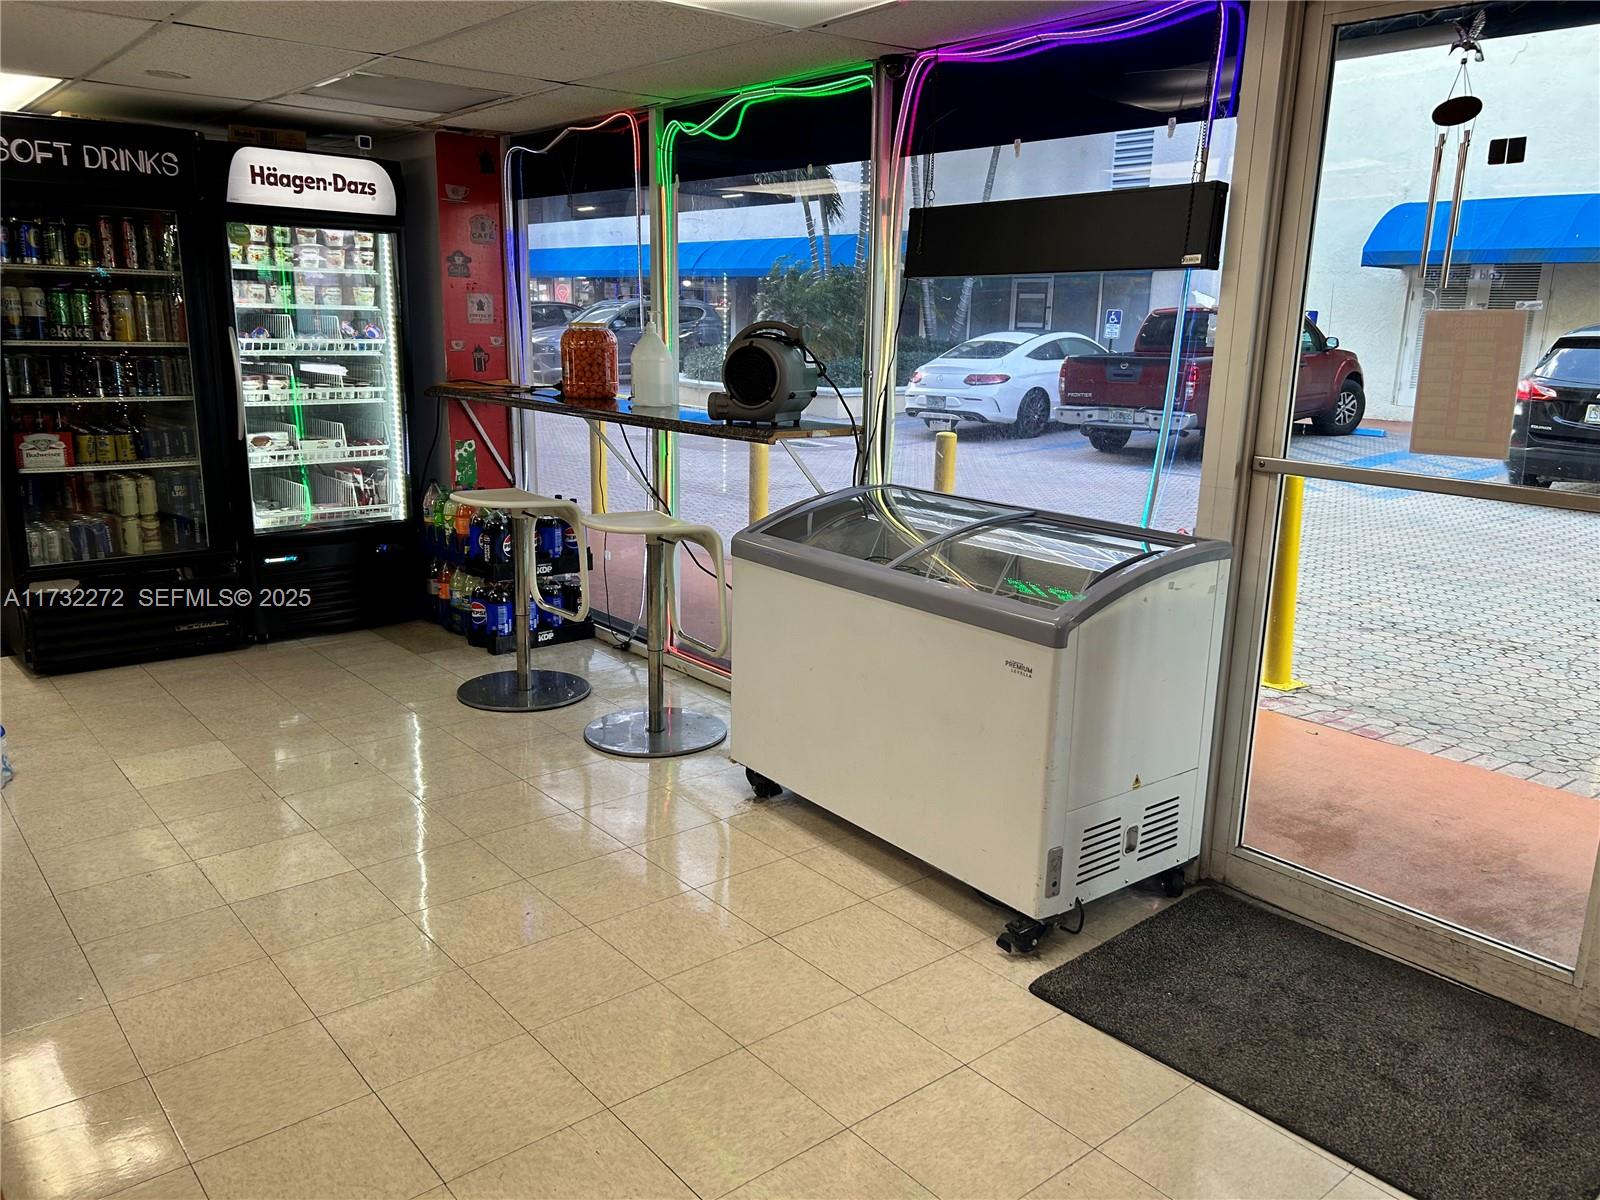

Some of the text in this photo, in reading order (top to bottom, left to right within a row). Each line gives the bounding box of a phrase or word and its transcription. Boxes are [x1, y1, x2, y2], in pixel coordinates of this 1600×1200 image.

[0, 135, 179, 177] SOFT DRINKS
[249, 164, 377, 196] Häagen-Dazs
[25, 451, 61, 459] Budweiser
[538, 632, 555, 642] KDP
[1004, 659, 1033, 674] PREMIUM
